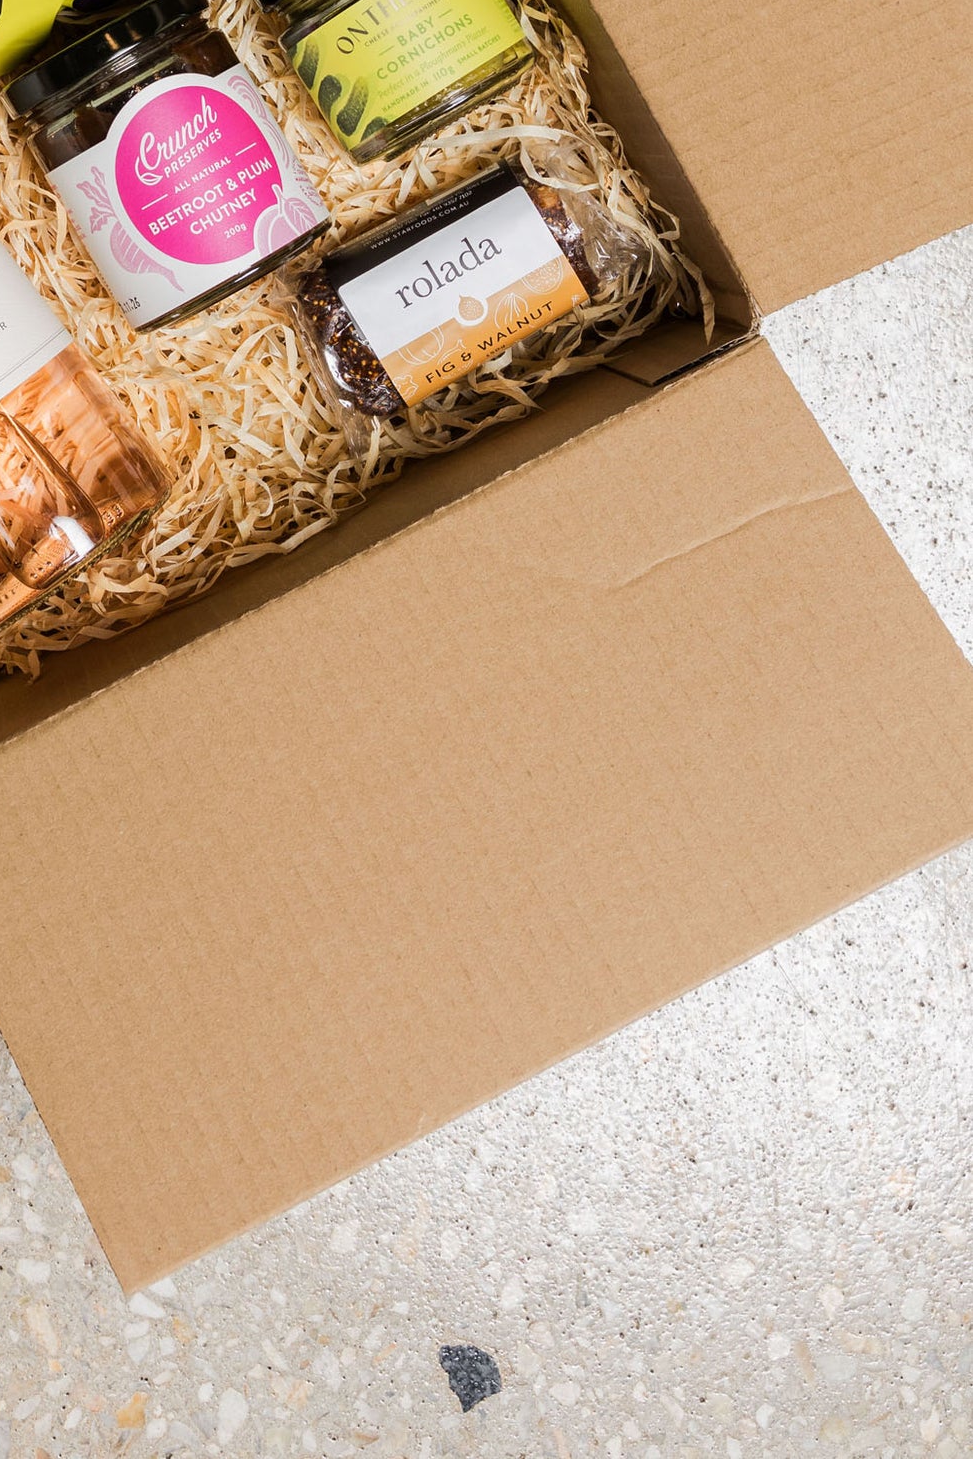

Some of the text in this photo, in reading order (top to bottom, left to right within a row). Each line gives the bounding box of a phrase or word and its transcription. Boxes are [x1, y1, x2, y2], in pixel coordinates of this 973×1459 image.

[336, 20, 369, 54] ON
[365, 29, 389, 48] CHEESE
[376, 13, 473, 80] CORNICHONS
[397, 15, 435, 47] BABY
[378, 77, 404, 99] Perfect
[405, 71, 415, 85] in
[383, 85, 419, 112] HANDMADE
[420, 81, 429, 89] IN
[457, 50, 479, 65] SMALL
[139, 95, 217, 172] Crunch
[164, 128, 222, 178] PRESERVES
[148, 183, 225, 236] BEETROOT
[226, 178, 239, 191] &
[237, 157, 272, 185] PLUM
[174, 156, 231, 194] ALL NATURAL
[190, 188, 257, 235] CHUTNEY
[224, 223, 247, 239] 200g
[395, 237, 502, 309] rolada
[425, 362, 456, 384] FIG
[461, 352, 472, 362] &
[477, 300, 553, 351] WALNUT
